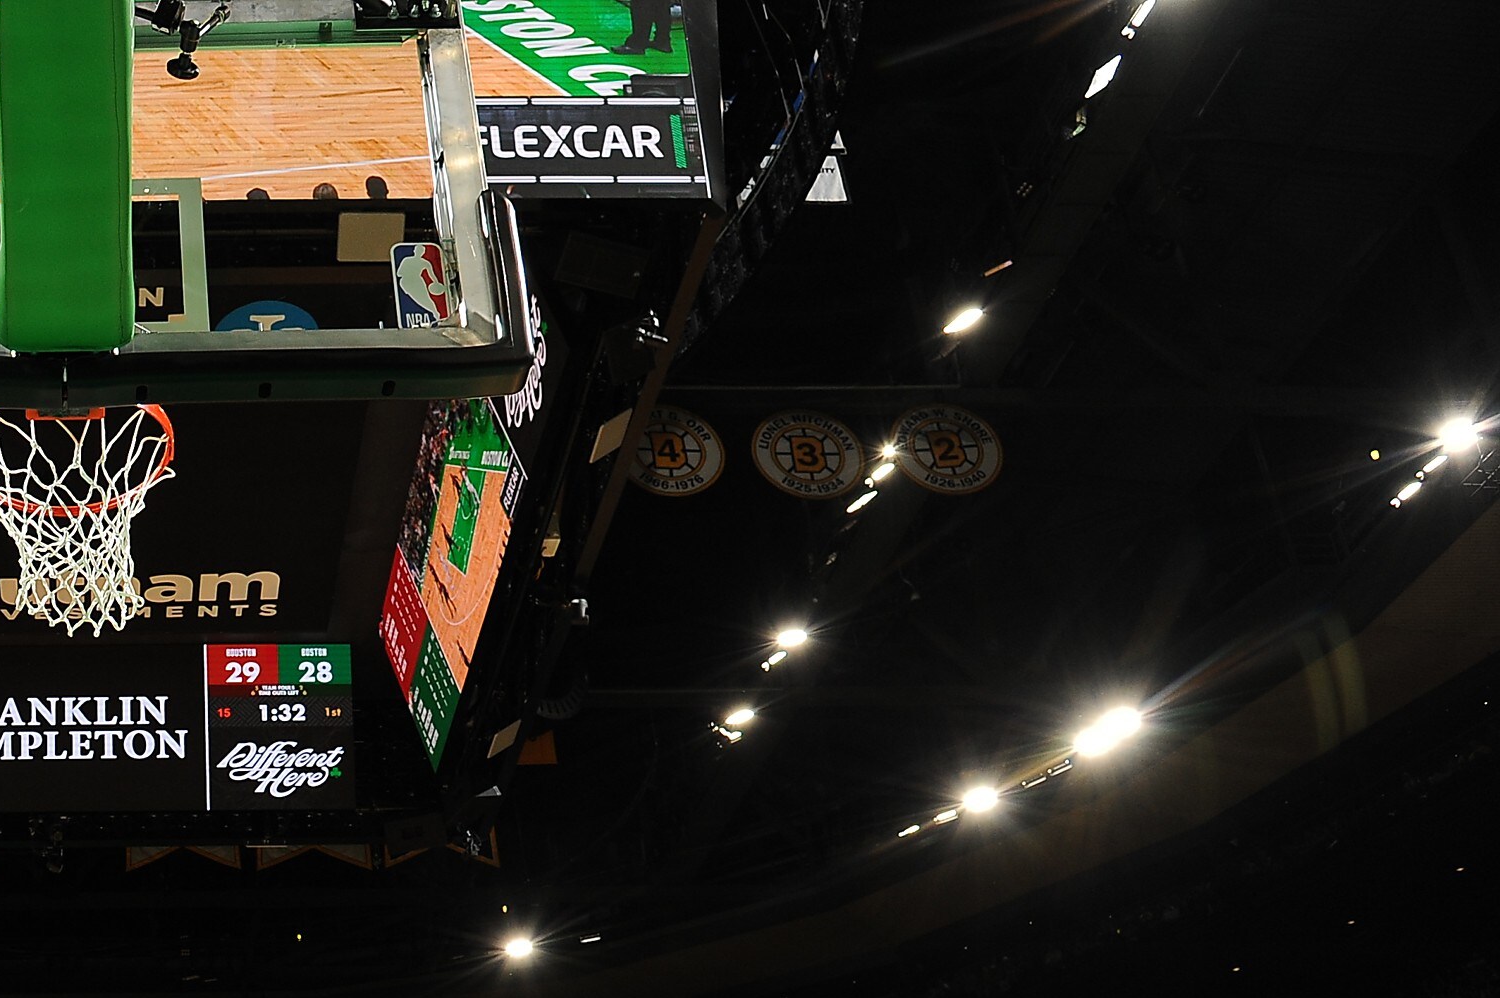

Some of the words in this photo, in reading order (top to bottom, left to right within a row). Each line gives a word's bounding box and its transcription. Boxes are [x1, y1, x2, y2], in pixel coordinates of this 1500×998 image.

[686, 420, 711, 441] ORR
[758, 418, 790, 450] LIONEL
[657, 439, 680, 462] 4
[796, 442, 819, 466] 3
[934, 438, 959, 461] 2
[639, 472, 704, 490] 1966-1976
[782, 477, 845, 493] 1925-1934
[925, 470, 987, 488] 1926-1940
[301, 648, 327, 657] BOSTON
[225, 661, 261, 683] 29
[298, 661, 333, 683] 28
[217, 708, 231, 718] 15
[258, 703, 306, 722] 1:32
[324, 707, 342, 717] 1st
[216, 741, 345, 774] Different
[237, 767, 330, 798] Here
